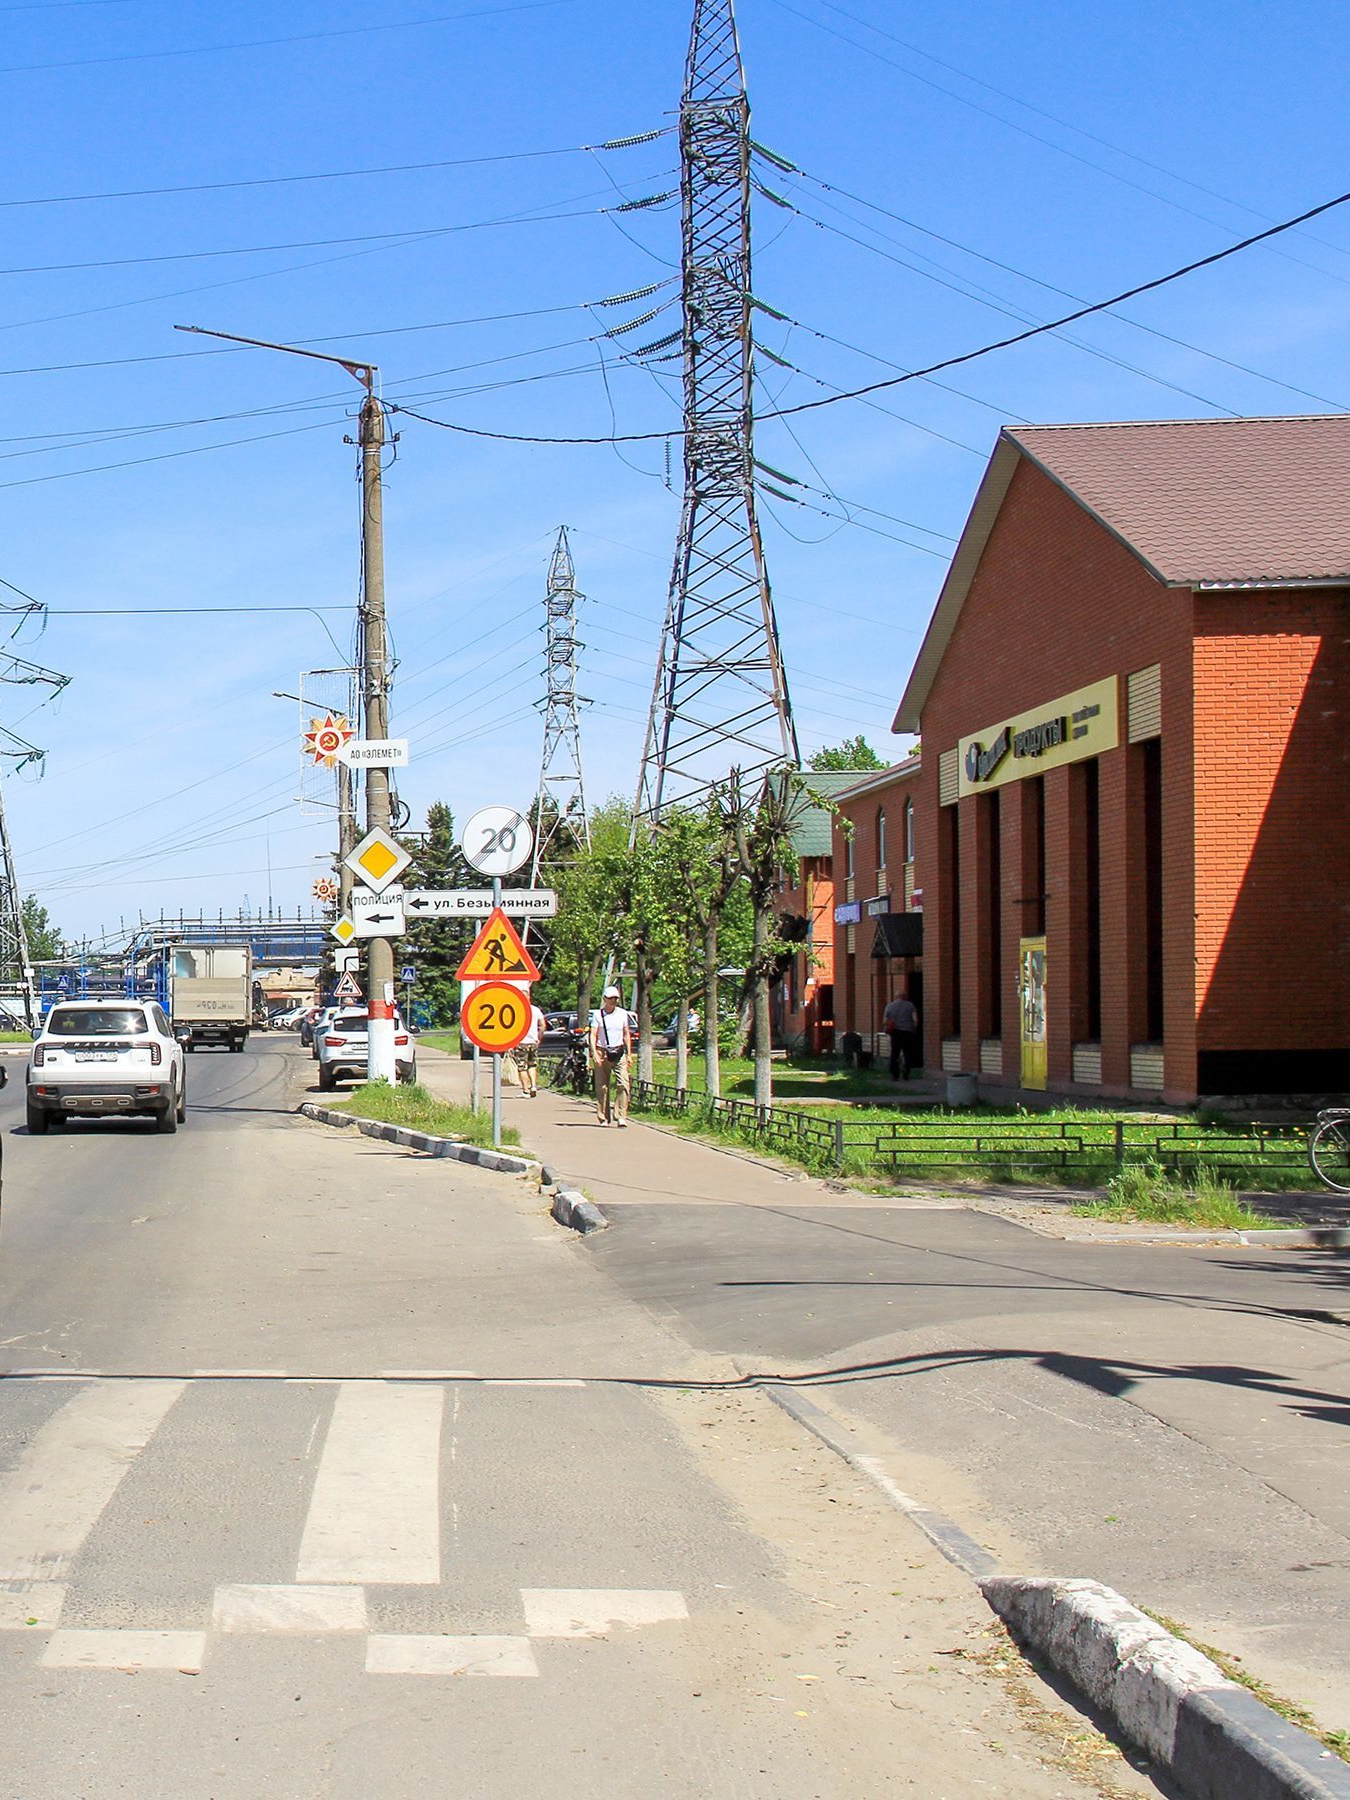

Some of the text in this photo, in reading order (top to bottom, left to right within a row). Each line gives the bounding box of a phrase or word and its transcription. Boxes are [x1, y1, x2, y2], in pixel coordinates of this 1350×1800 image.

[1014, 716, 1064, 758] ПРОДУКТЫ
[350, 748, 402, 760] АО «ЭЛЕМЕТ»
[481, 827, 517, 854] 20
[353, 894, 403, 906] ПОЛИЦИЯ
[433, 900, 454, 909] ул.
[478, 1003, 516, 1030] 20
